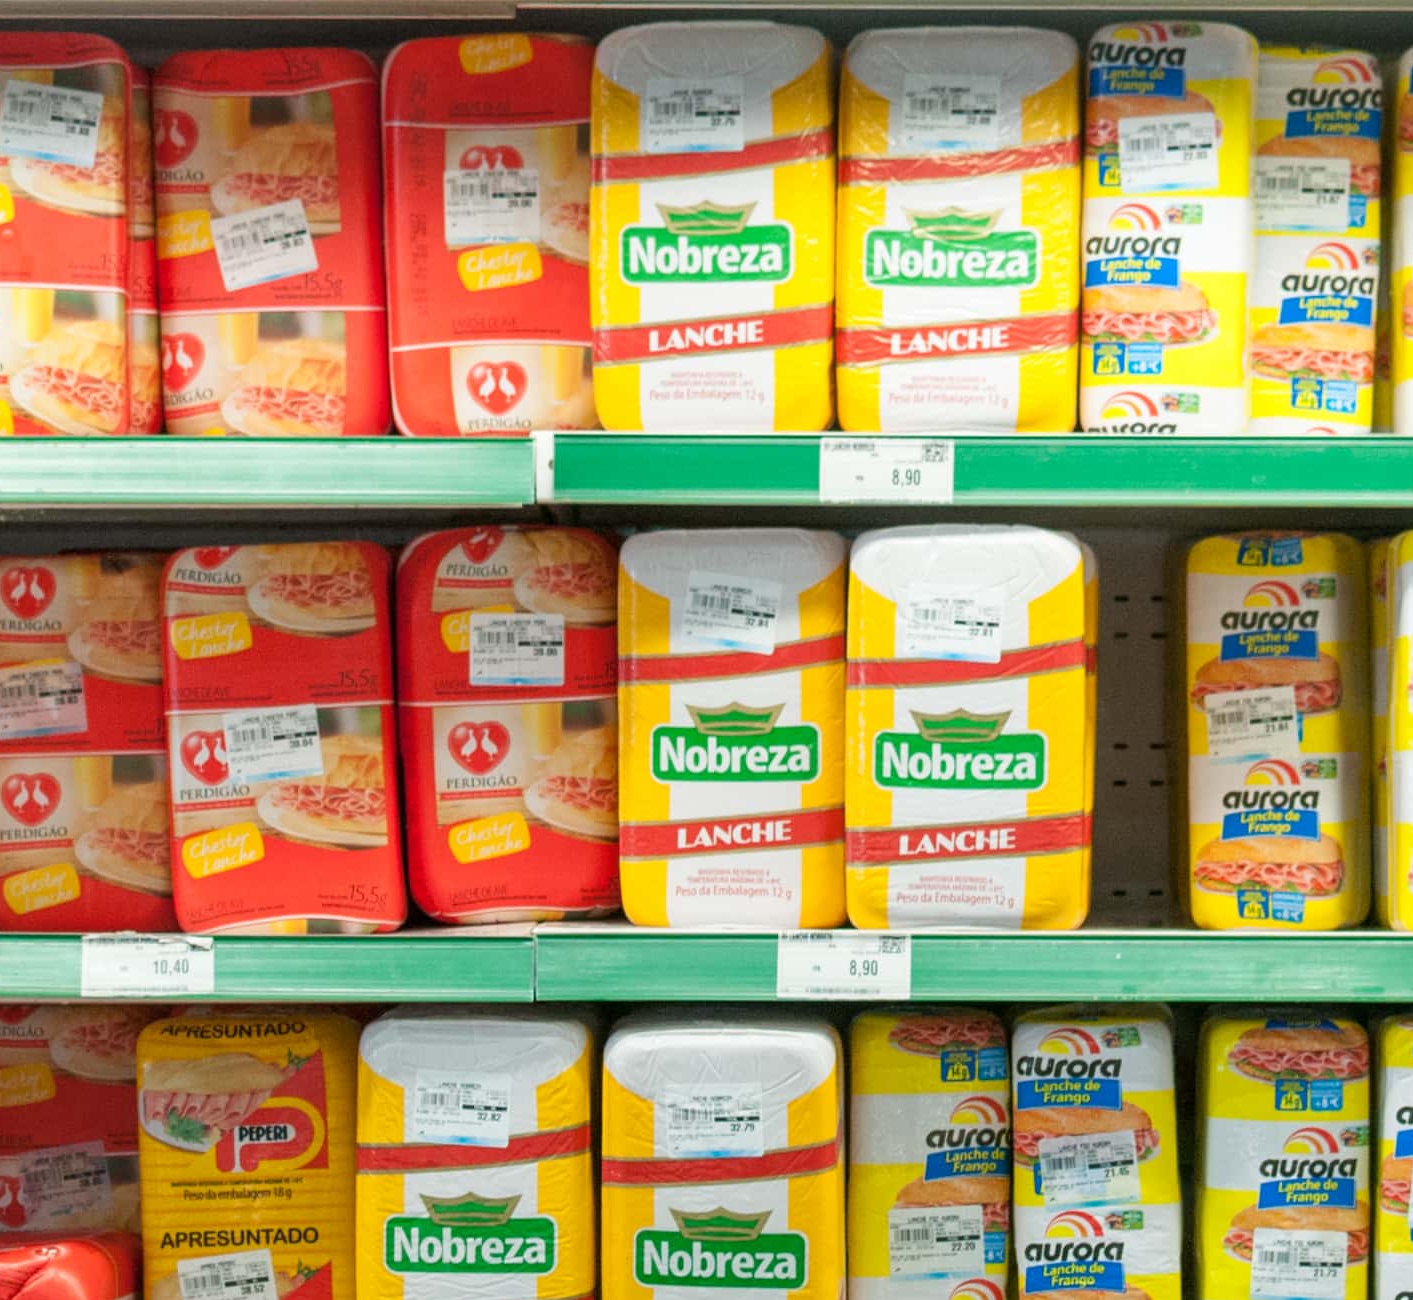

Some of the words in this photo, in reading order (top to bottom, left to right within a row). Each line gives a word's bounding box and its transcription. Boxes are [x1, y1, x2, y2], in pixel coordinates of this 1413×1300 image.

[1089, 42, 1186, 68] aurora
[629, 235, 783, 276] Nobreza
[1085, 234, 1181, 259] aurora
[873, 245, 1030, 279] Nobreza
[649, 322, 764, 352] LANCHE
[891, 326, 1009, 354] LANCHE
[175, 568, 241, 586] PERDIGÃO
[1220, 609, 1318, 630] aurora
[659, 737, 811, 773] Nobreza
[882, 748, 1036, 781] Nobreza
[0, 825, 68, 840] PERDIGÃO
[677, 822, 792, 850] LANCHE
[899, 828, 1016, 856] LANCHE
[153, 958, 190, 976] 10,40
[849, 960, 878, 978] 8,90
[1017, 1056, 1121, 1078] aurora
[1259, 1157, 1357, 1179] aurora
[160, 1228, 319, 1249] APRESUNTADO
[394, 1228, 546, 1265] Nobreza
[1024, 1240, 1124, 1262] aurora
